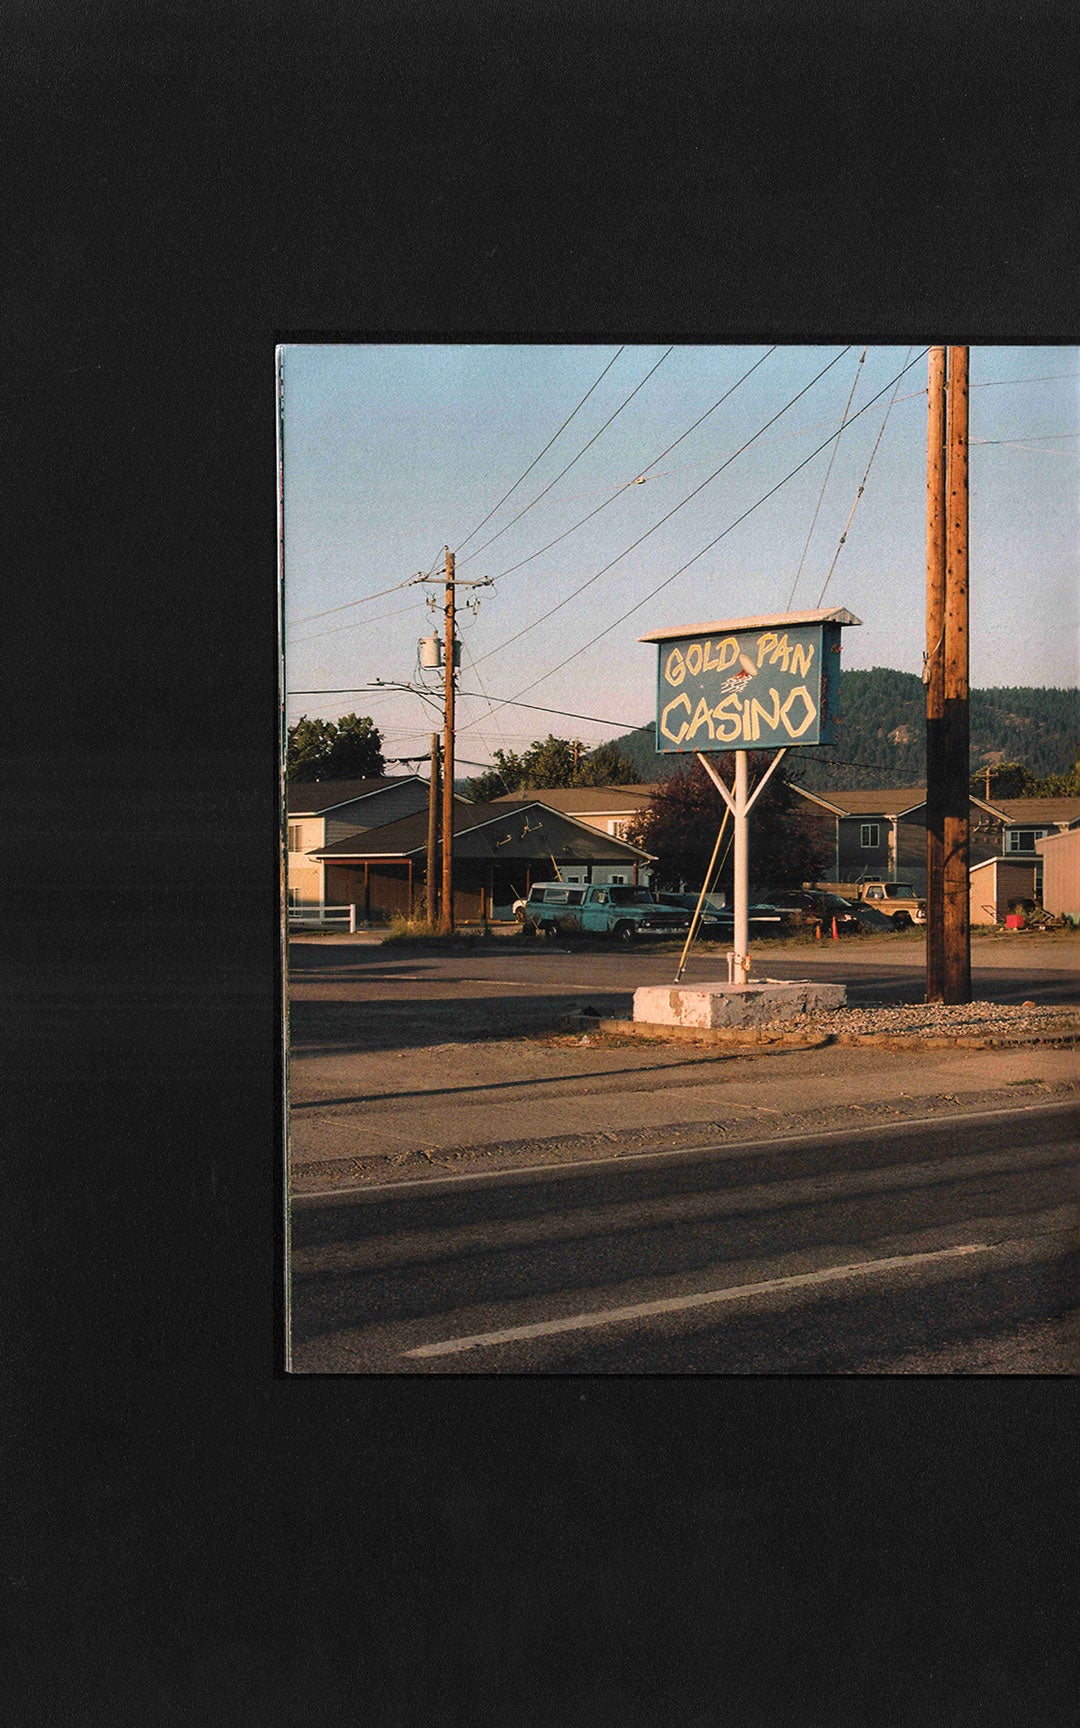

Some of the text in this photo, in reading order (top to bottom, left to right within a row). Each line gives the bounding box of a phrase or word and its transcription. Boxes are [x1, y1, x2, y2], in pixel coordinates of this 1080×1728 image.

[665, 633, 814, 687] GOLD PAN
[660, 685, 817, 745] CASINO
